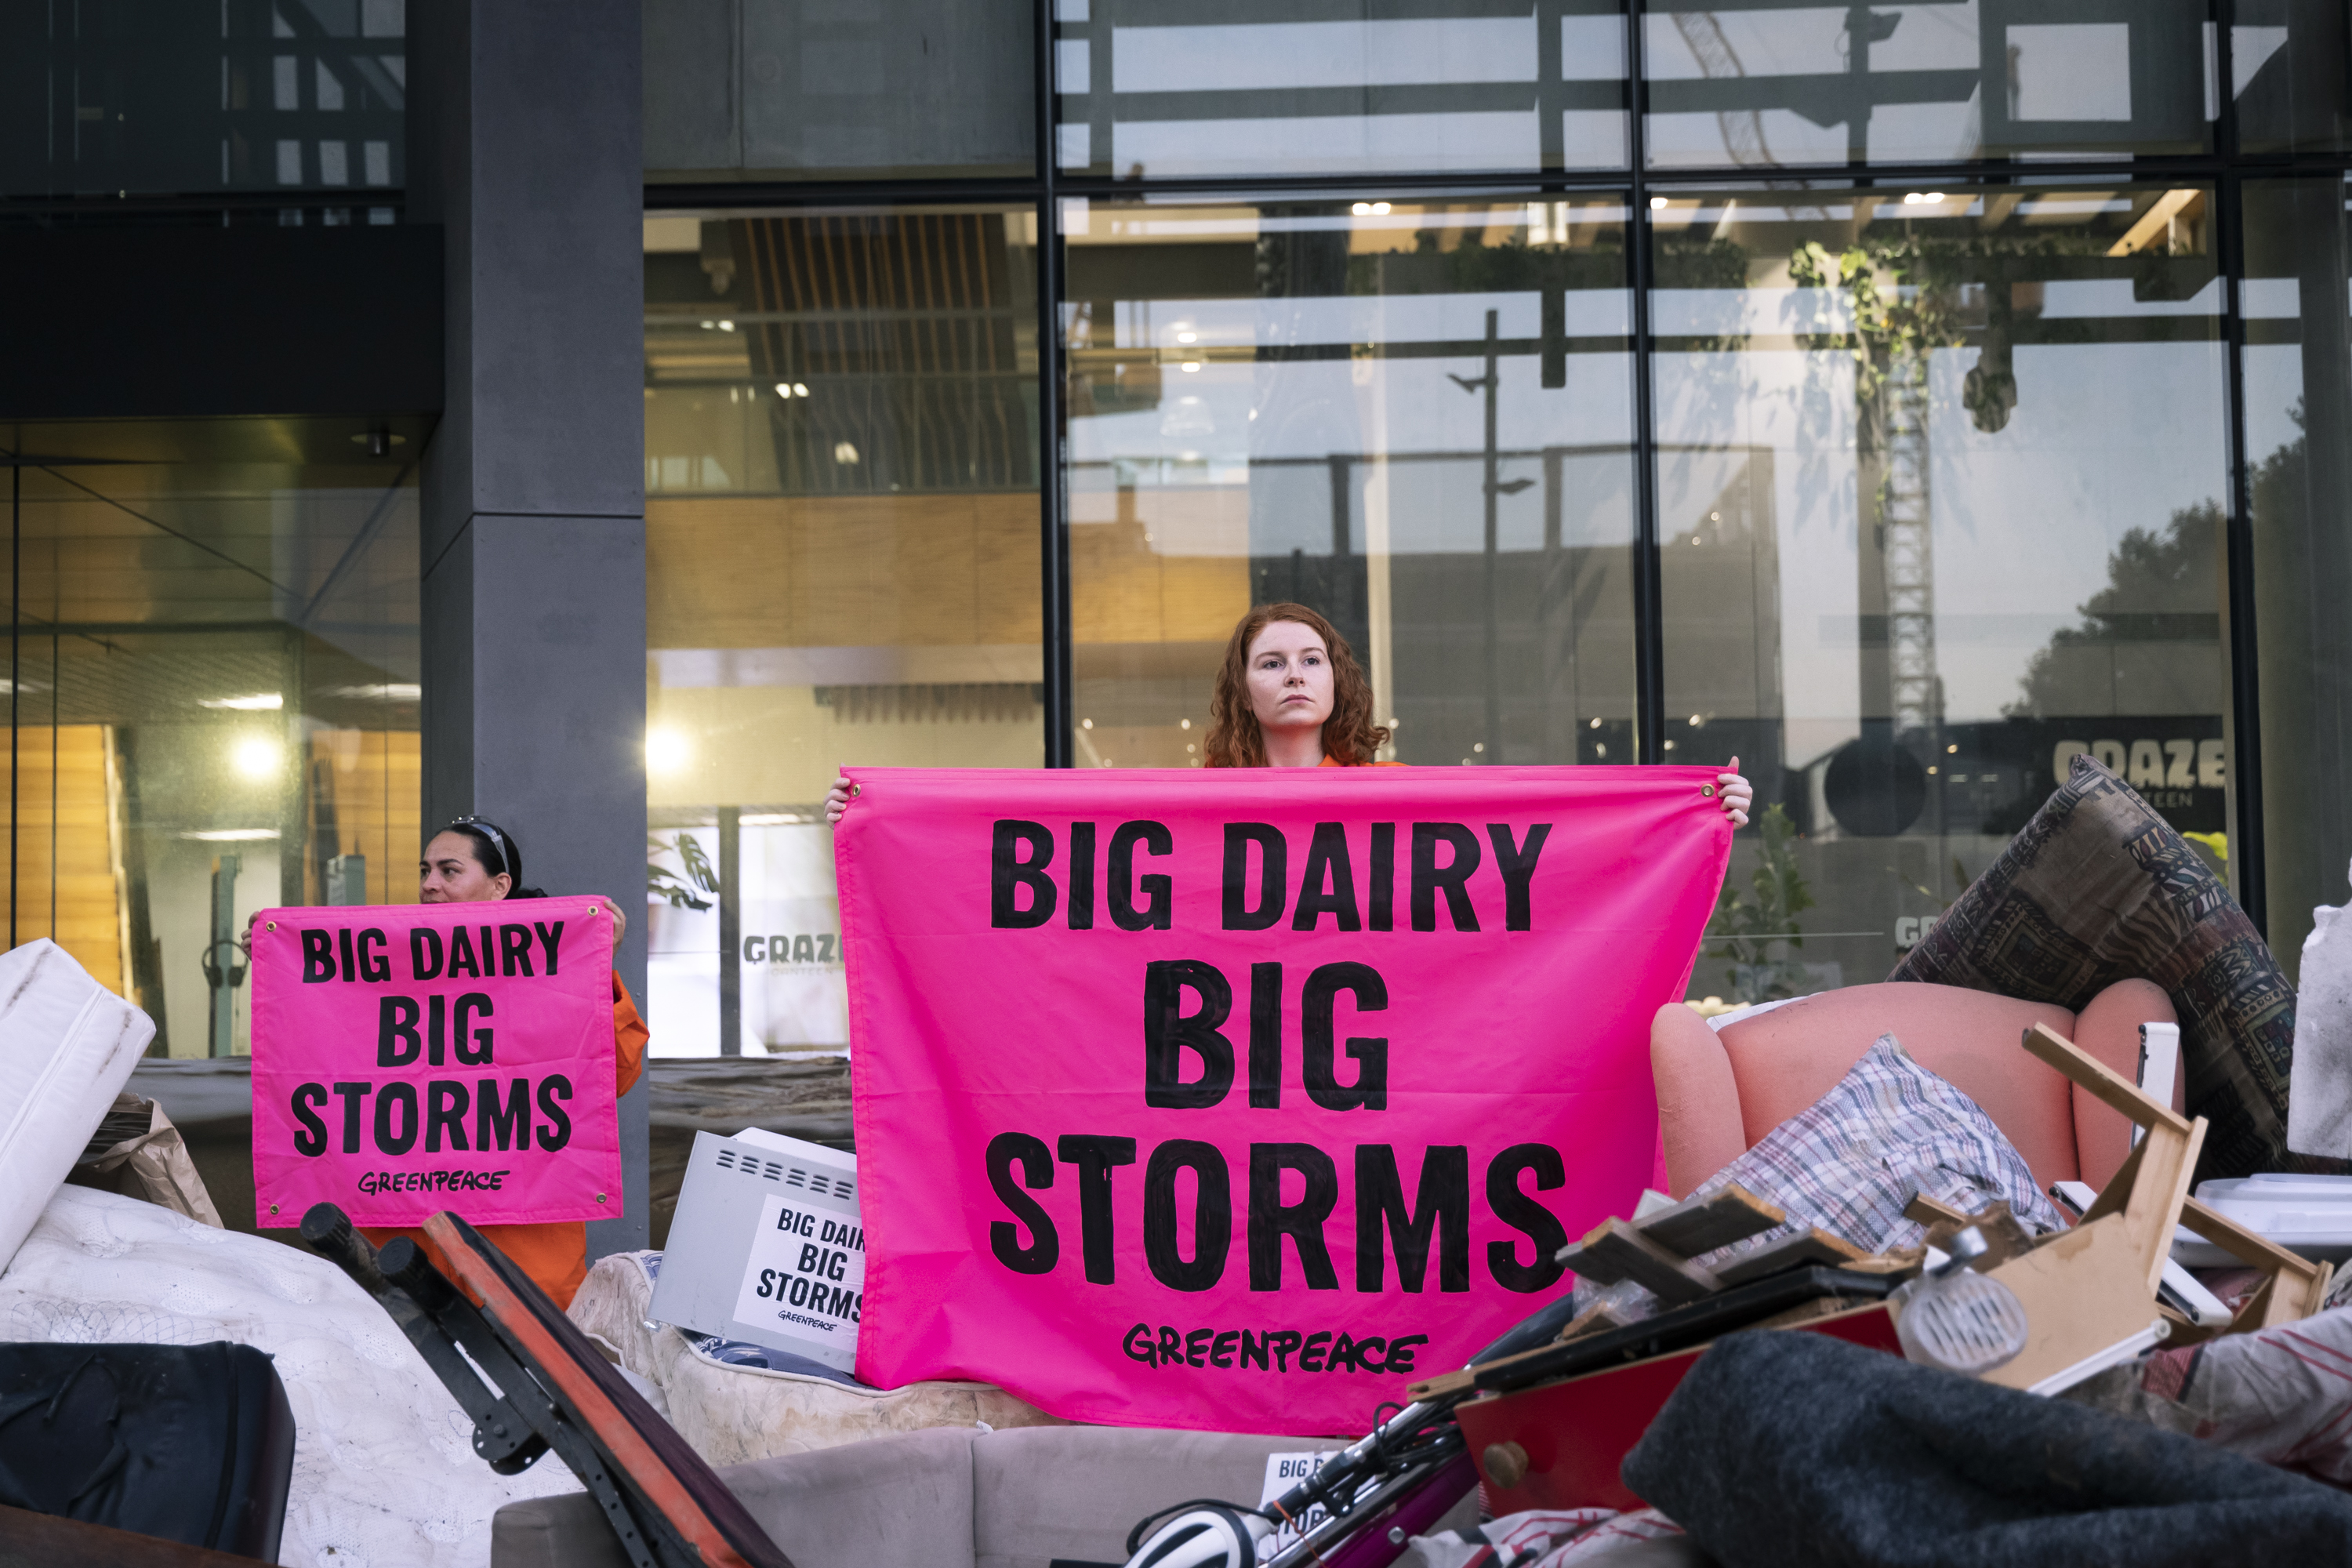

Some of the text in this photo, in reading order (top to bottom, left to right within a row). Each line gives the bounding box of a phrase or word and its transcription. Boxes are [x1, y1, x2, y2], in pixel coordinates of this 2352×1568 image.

[2143, 792, 2193, 808] TEEN
[991, 819, 1553, 933] BIG DAIRY
[300, 921, 564, 984] BIG DAIRY
[744, 934, 844, 964] GRAZ
[376, 992, 494, 1068] BIG
[1143, 959, 1388, 1112] BIG
[291, 1073, 574, 1157] STORMS
[358, 1170, 510, 1196] GREENPEACE
[777, 1207, 866, 1252] BIG DAI
[985, 1131, 1569, 1294] STORMS
[797, 1243, 848, 1282] BIG
[778, 1310, 837, 1332] GREENPEACE
[1122, 1323, 1429, 1375] GREENPEACE
[1279, 1459, 1308, 1478] BIG
